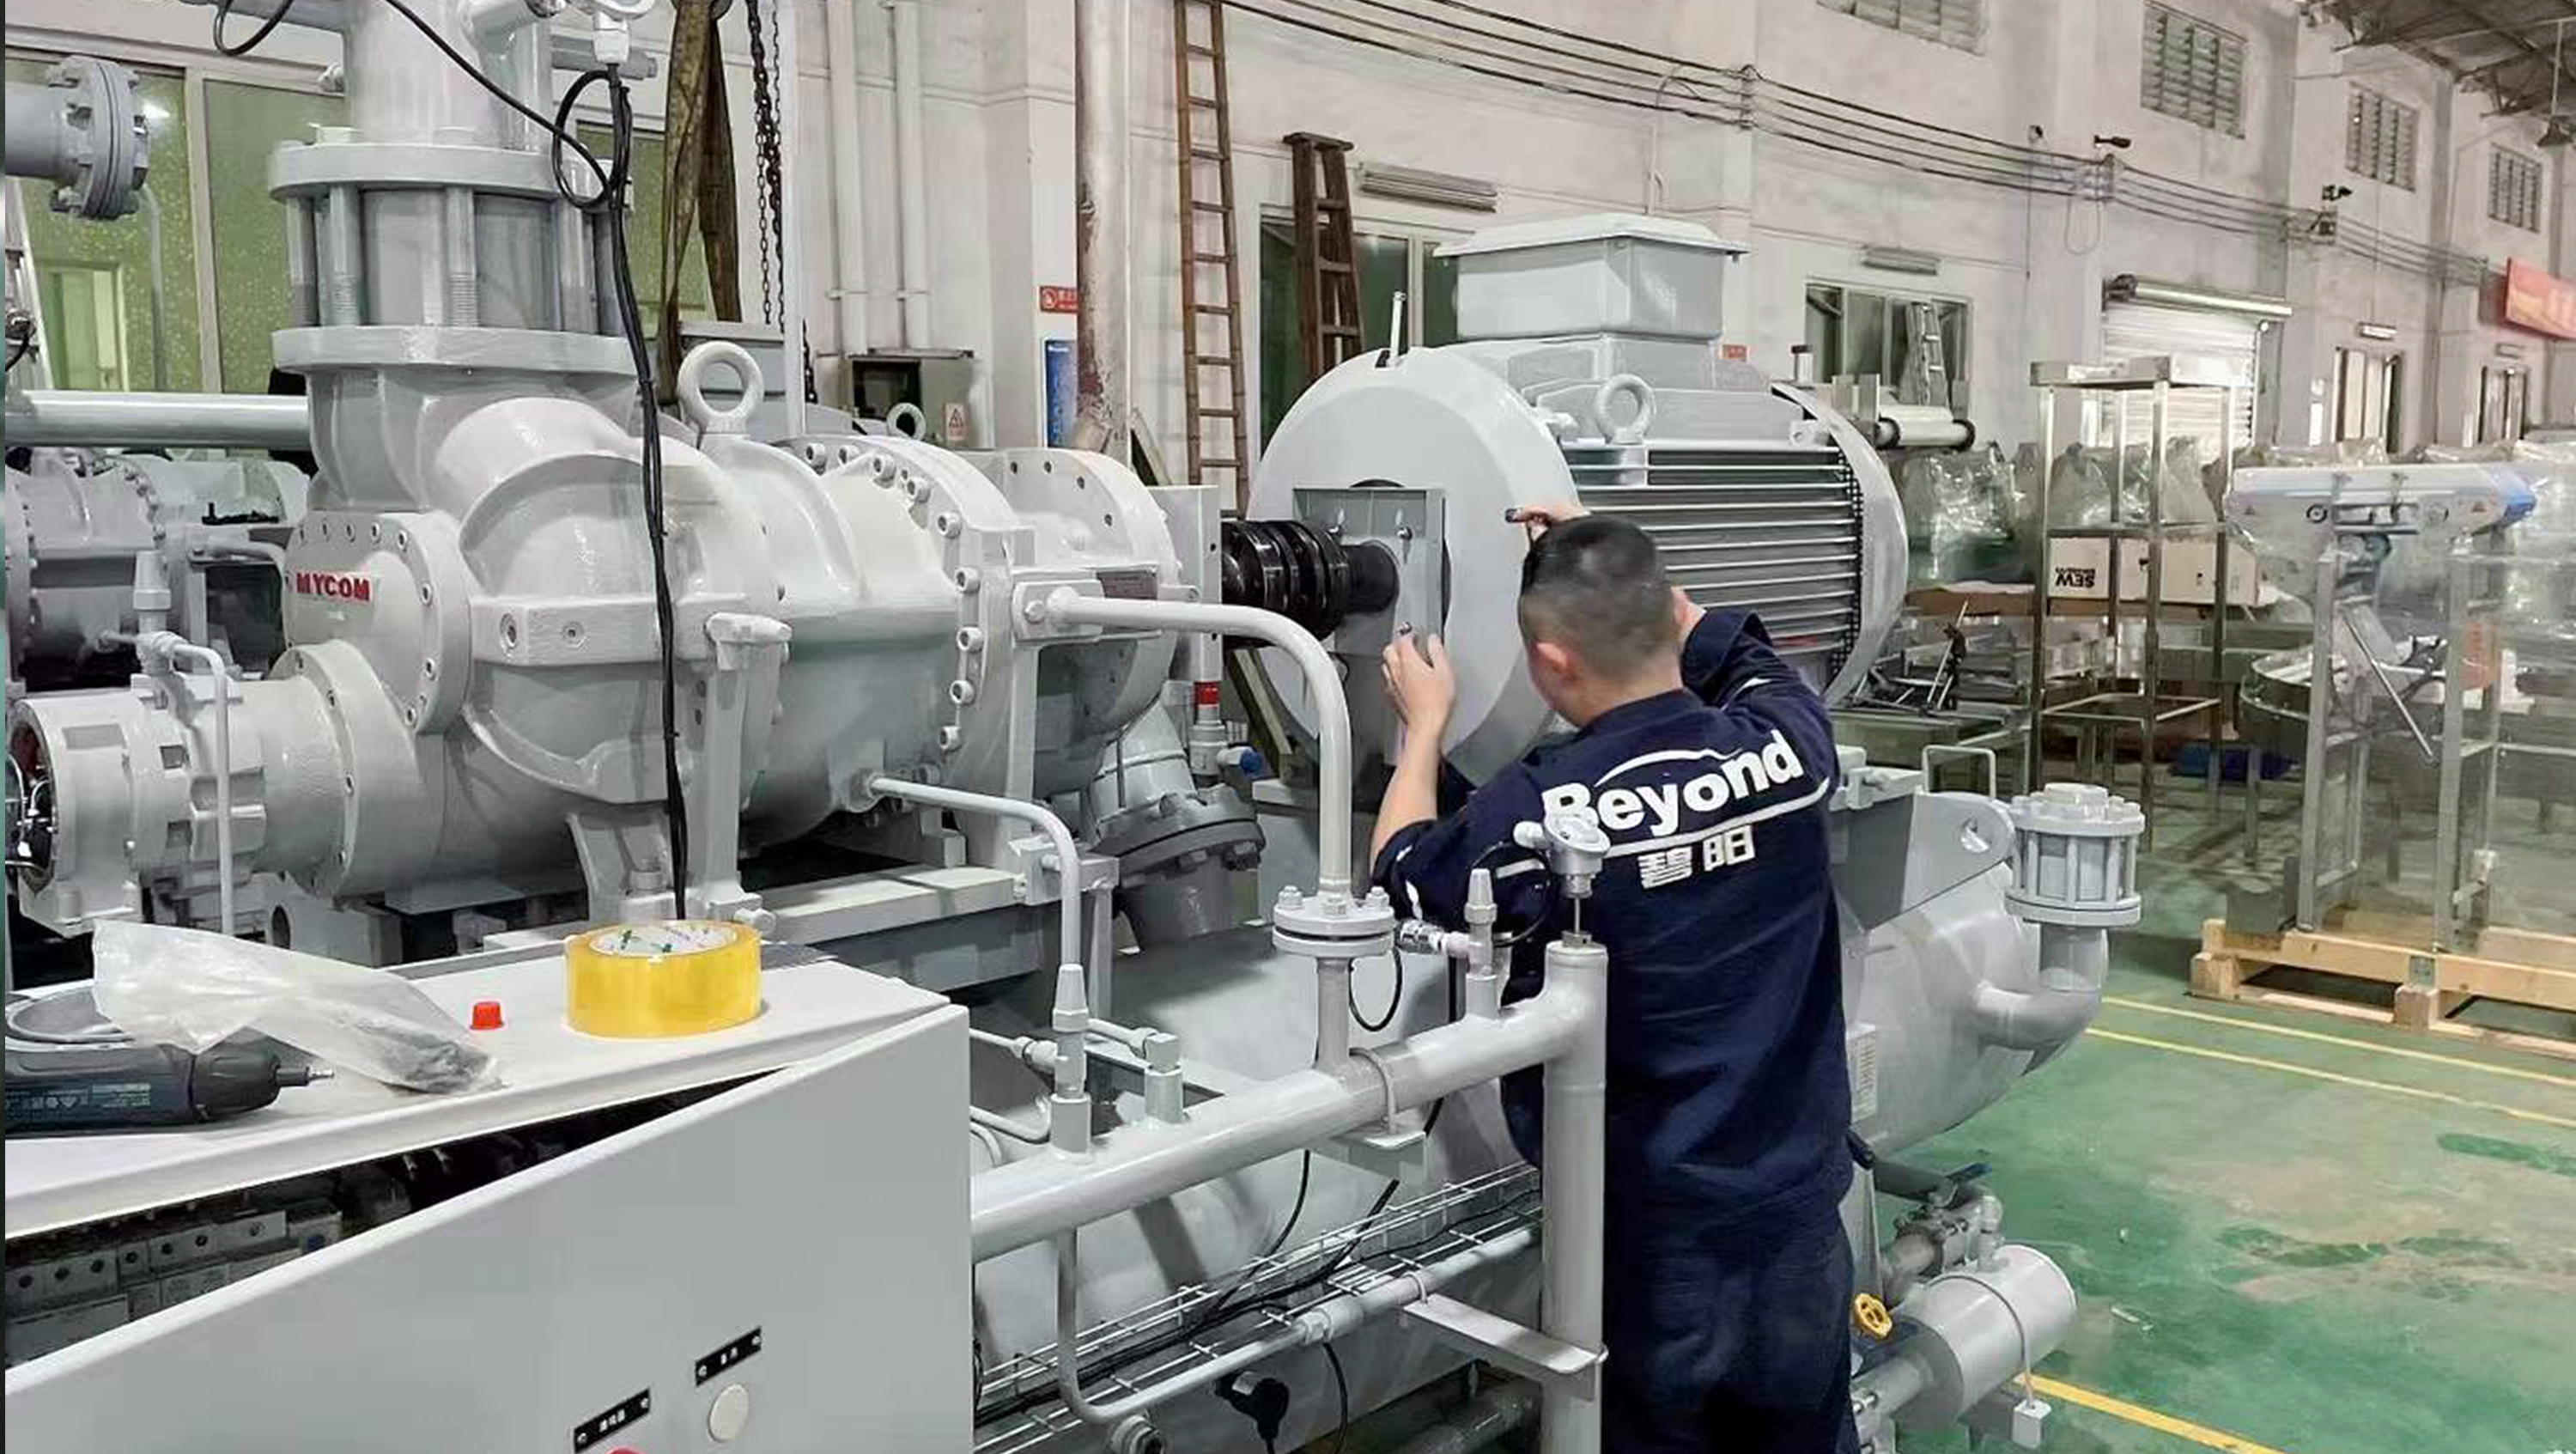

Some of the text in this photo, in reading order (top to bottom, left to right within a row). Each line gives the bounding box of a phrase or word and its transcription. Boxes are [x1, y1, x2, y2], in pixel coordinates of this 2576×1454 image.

[296, 572, 369, 601] MYCOM
[2056, 574, 2095, 587] SEW
[1542, 729, 1804, 837] Beyond
